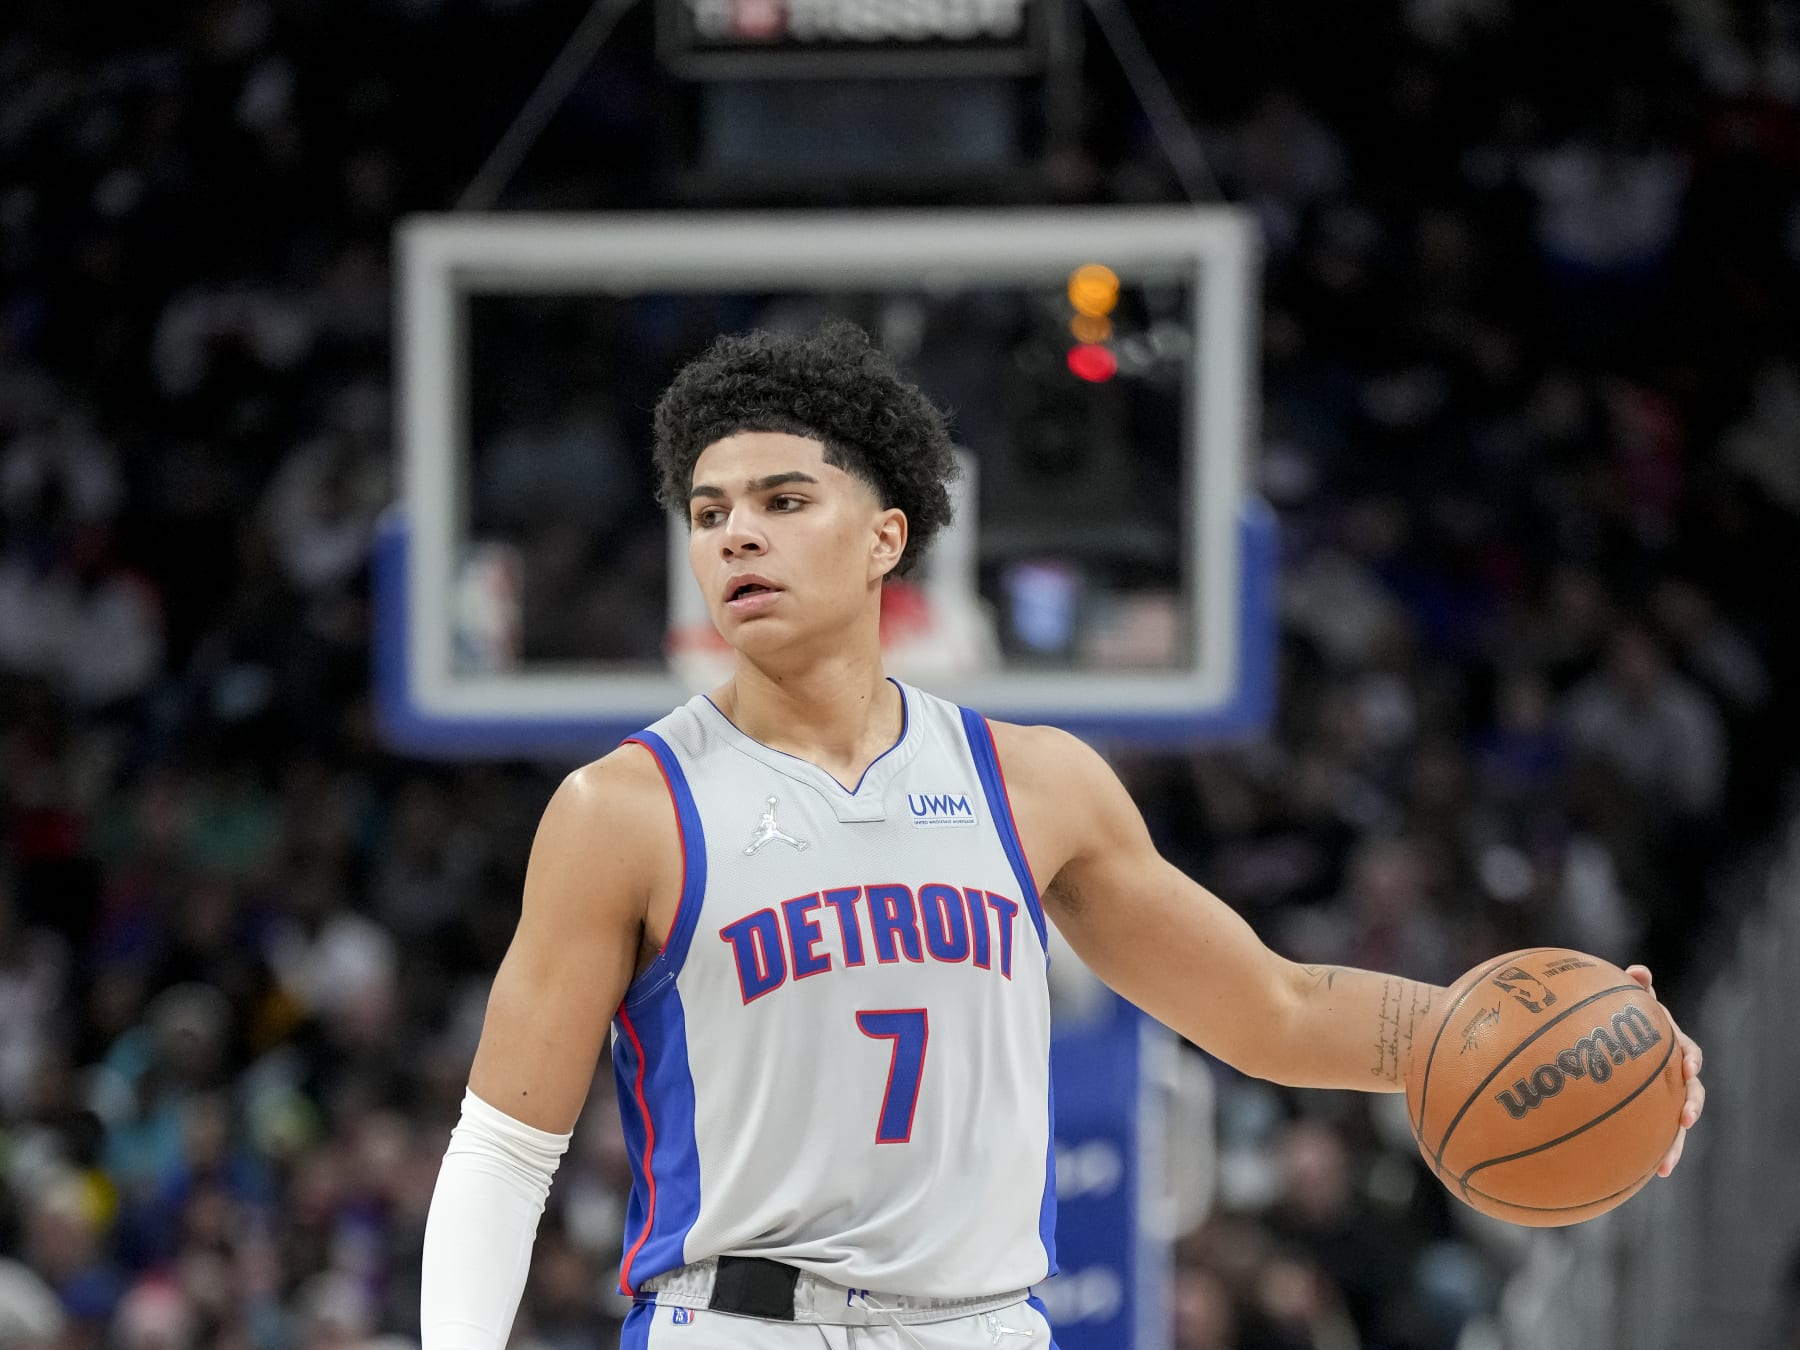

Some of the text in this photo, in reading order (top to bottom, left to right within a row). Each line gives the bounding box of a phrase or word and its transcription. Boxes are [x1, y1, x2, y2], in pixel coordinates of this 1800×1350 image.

[907, 794, 972, 817] UWM
[719, 883, 1019, 1006] DETROIT
[855, 1007, 930, 1145] 7
[1495, 1004, 1662, 1120] Wilson
